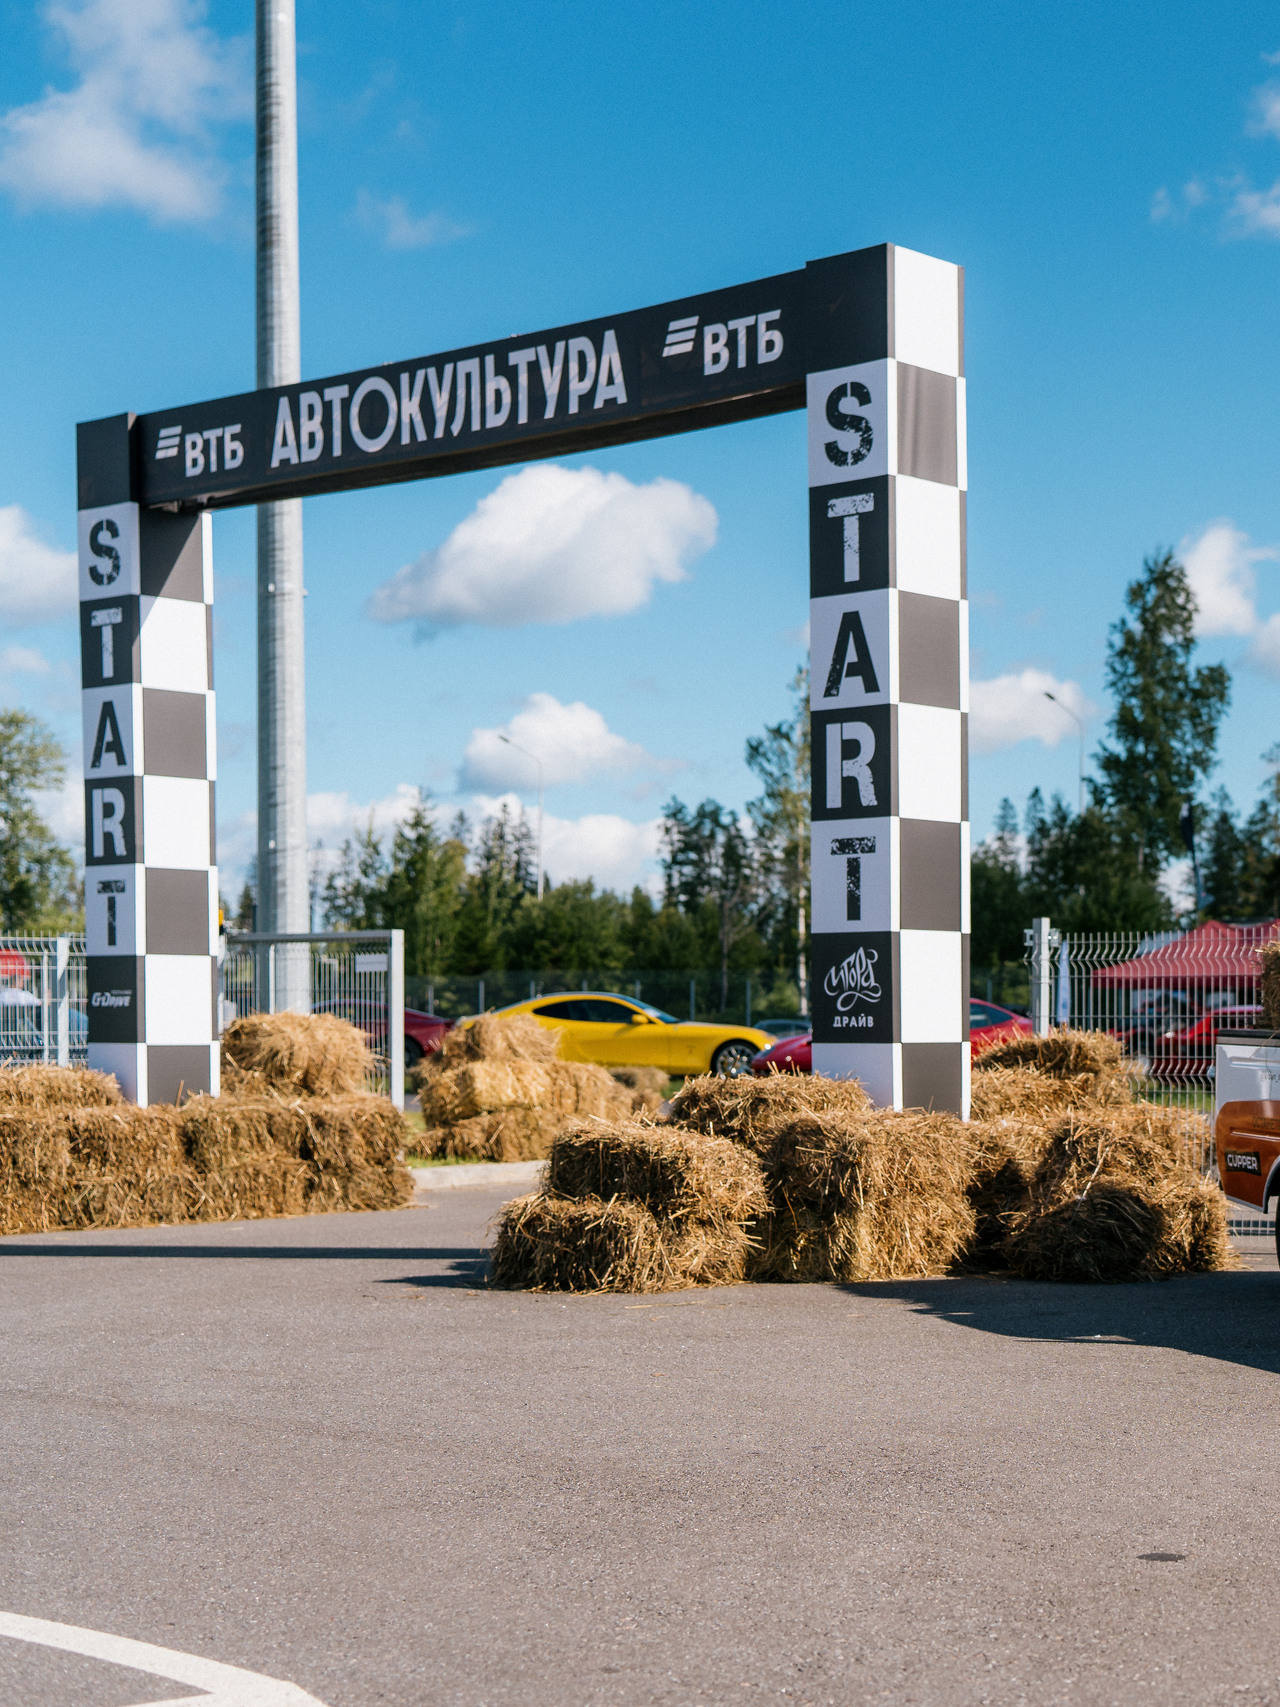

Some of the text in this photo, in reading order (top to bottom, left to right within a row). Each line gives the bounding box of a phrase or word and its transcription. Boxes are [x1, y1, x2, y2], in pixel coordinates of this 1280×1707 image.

[703, 309, 784, 376] ВТБ
[270, 329, 628, 469] АВТОКУЛЬТУРА
[184, 424, 245, 478] ВТБ
[824, 380, 881, 922] START
[88, 517, 128, 947] START
[833, 1013, 874, 1028] ДРАЙВ
[1226, 1153, 1258, 1170] CUPPER
